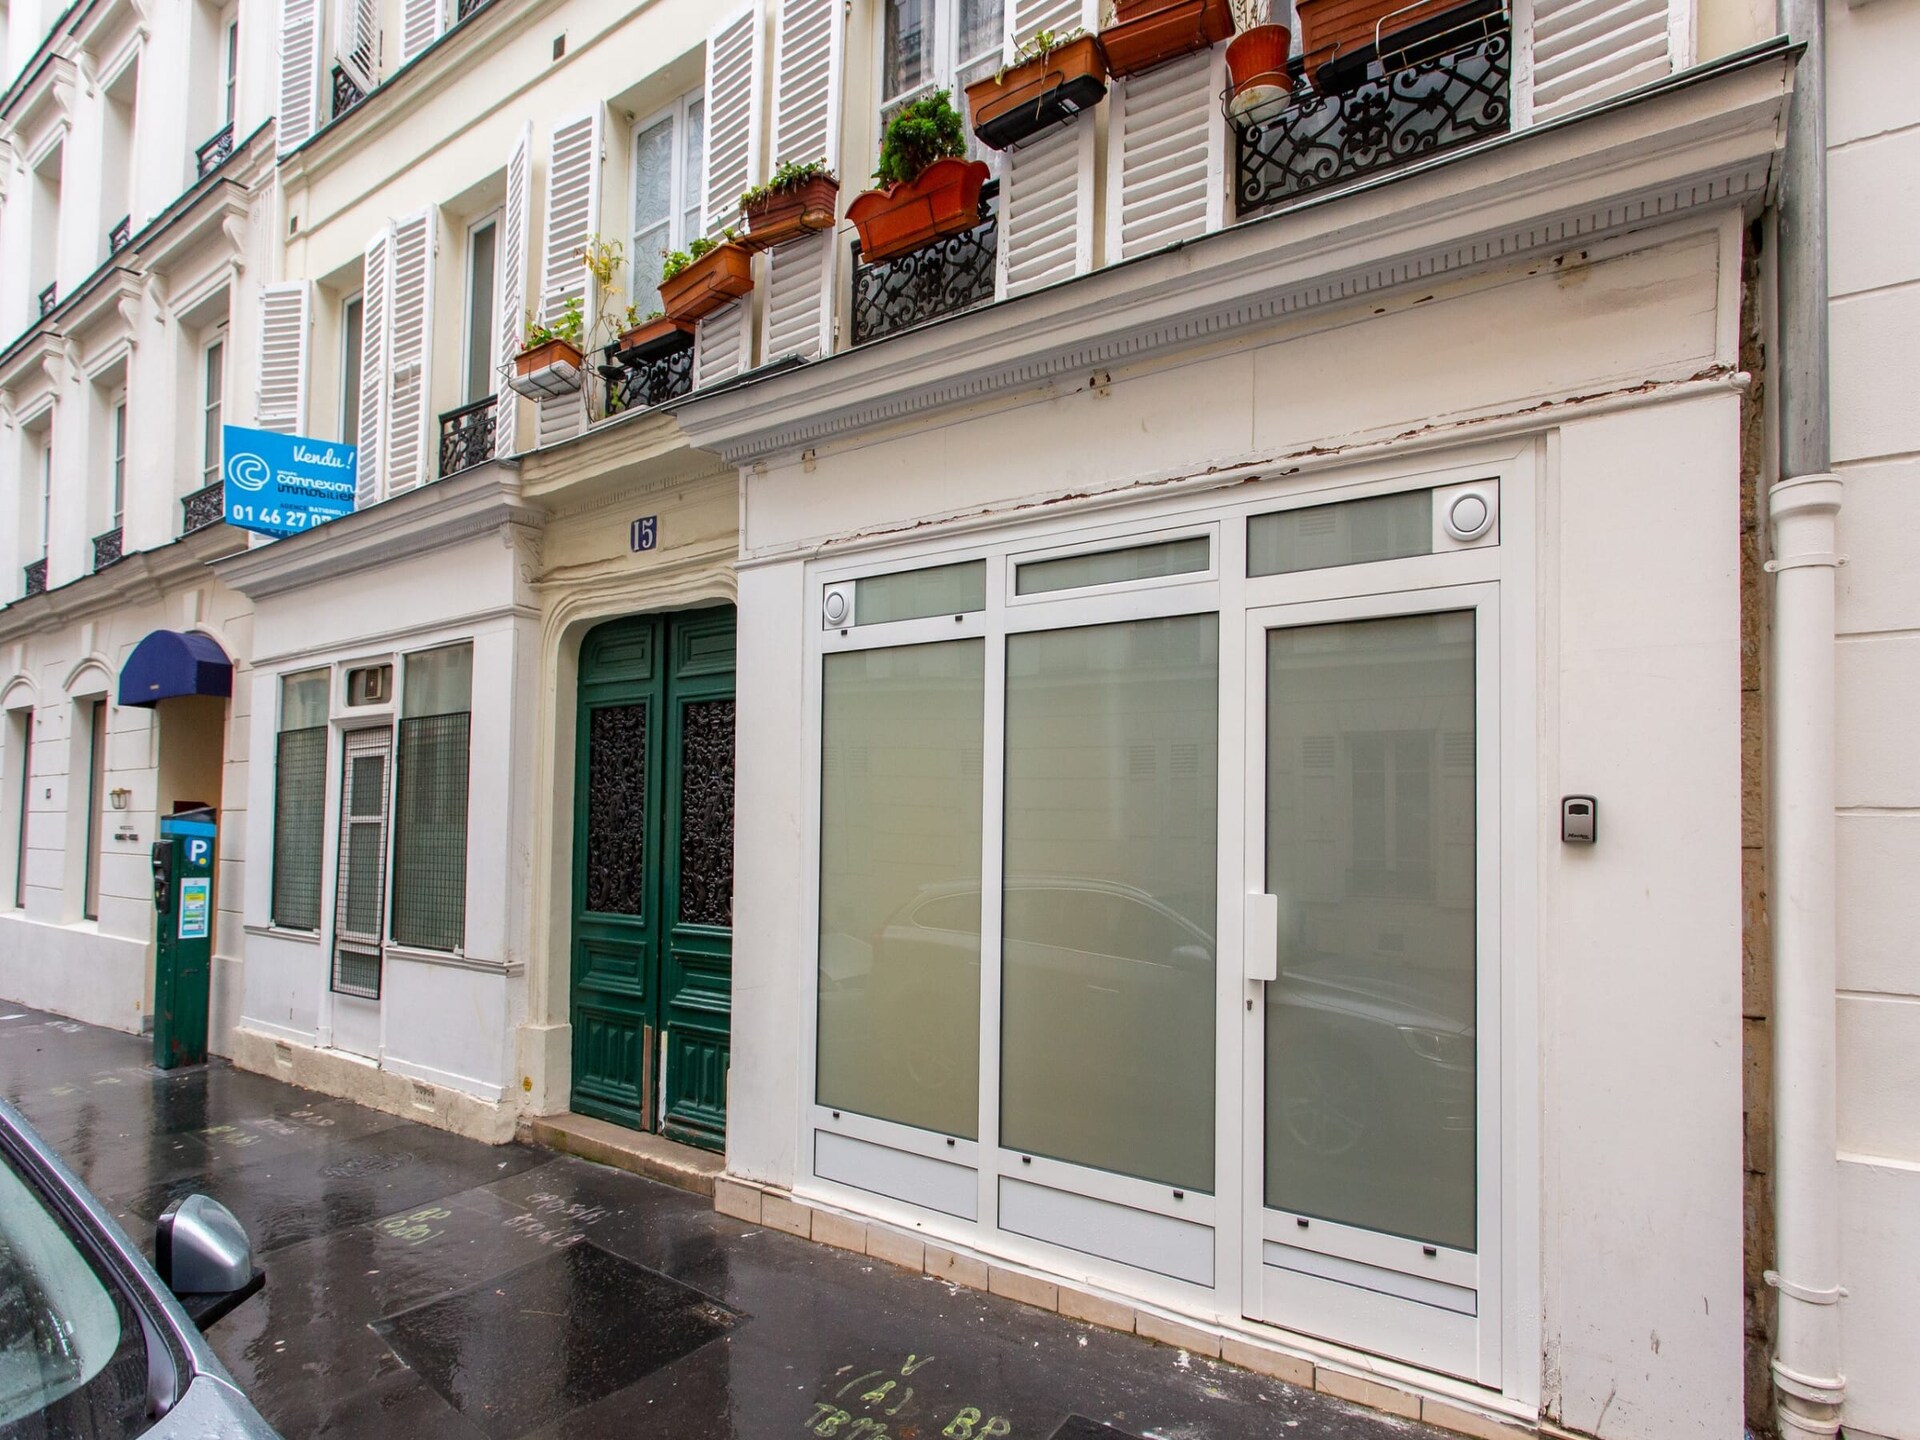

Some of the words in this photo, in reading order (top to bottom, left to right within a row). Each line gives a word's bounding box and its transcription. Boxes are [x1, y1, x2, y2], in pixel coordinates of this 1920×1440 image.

[277, 474, 355, 493] connexion
[233, 505, 253, 521] 01
[259, 508, 281, 524] 46
[286, 511, 307, 527] 27
[633, 518, 654, 551] 15
[190, 839, 208, 862] P
